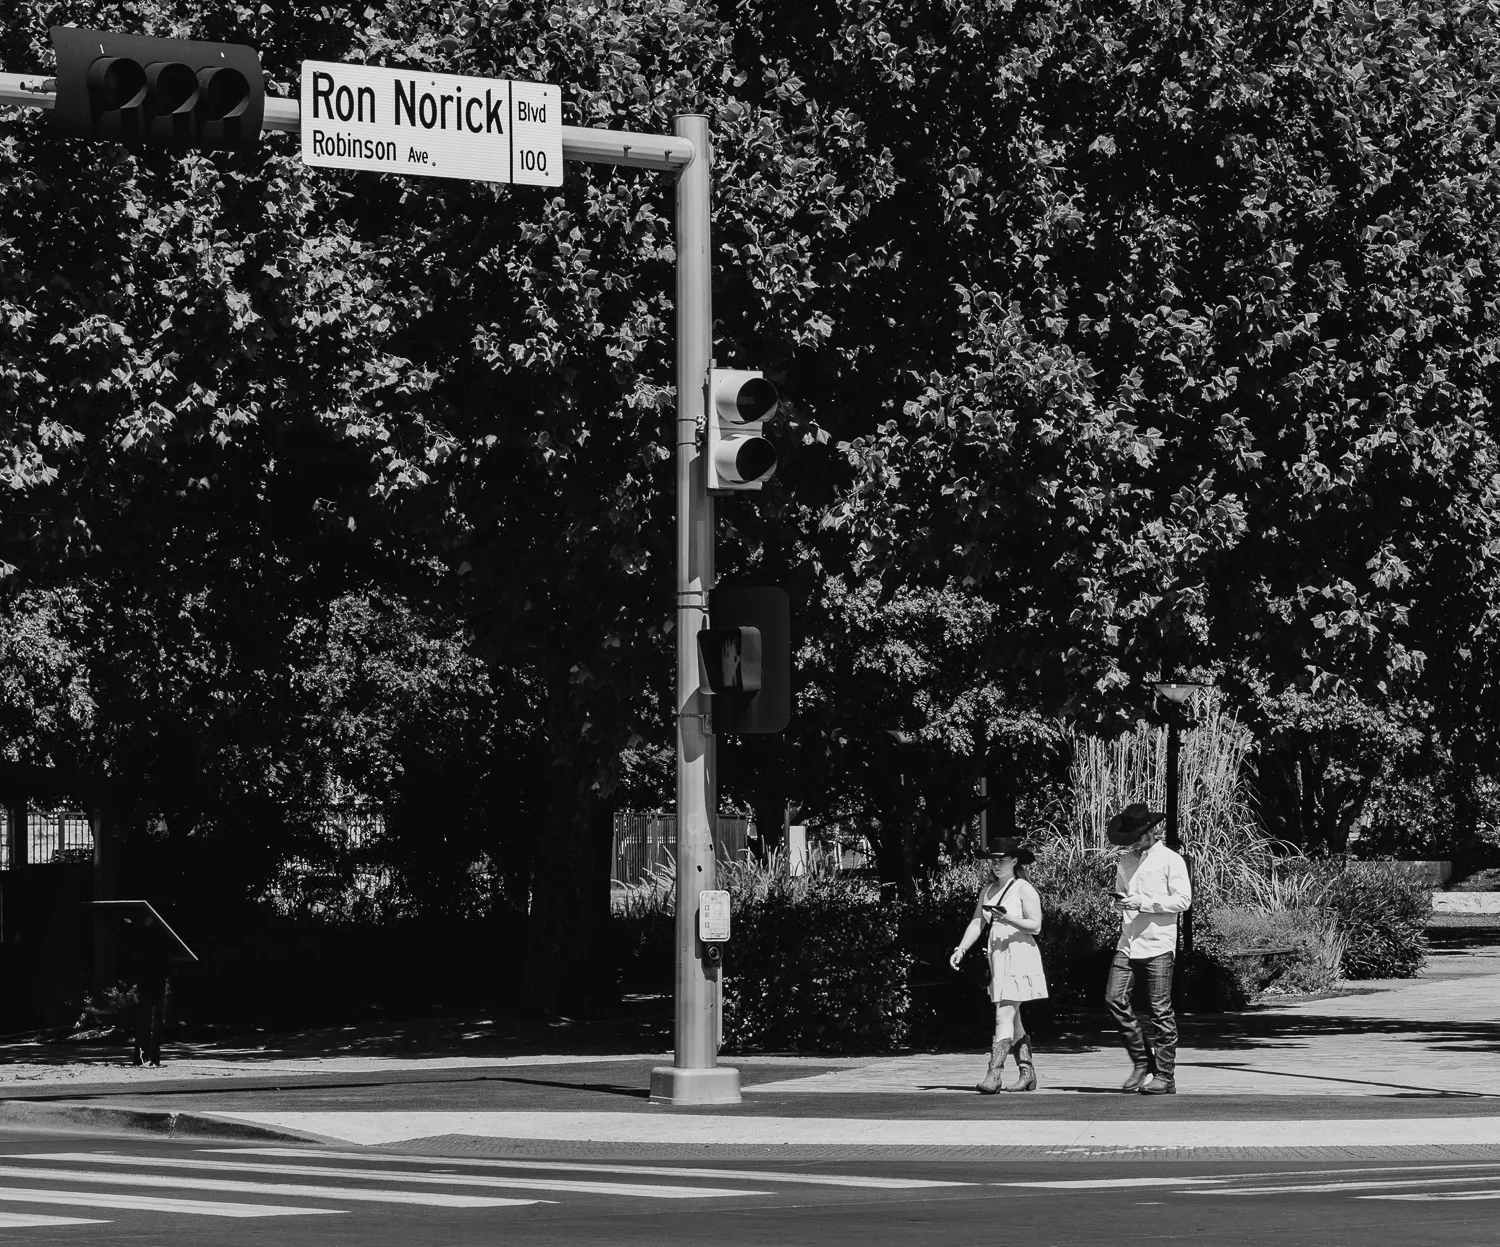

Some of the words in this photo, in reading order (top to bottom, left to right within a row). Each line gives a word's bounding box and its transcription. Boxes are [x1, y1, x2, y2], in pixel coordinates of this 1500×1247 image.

[312, 71, 376, 124] Ron
[394, 78, 504, 135] Norick
[518, 100, 547, 124] Blvd
[312, 129, 397, 161] Robinson
[407, 146, 429, 164] Ave
[519, 149, 547, 172] 100
